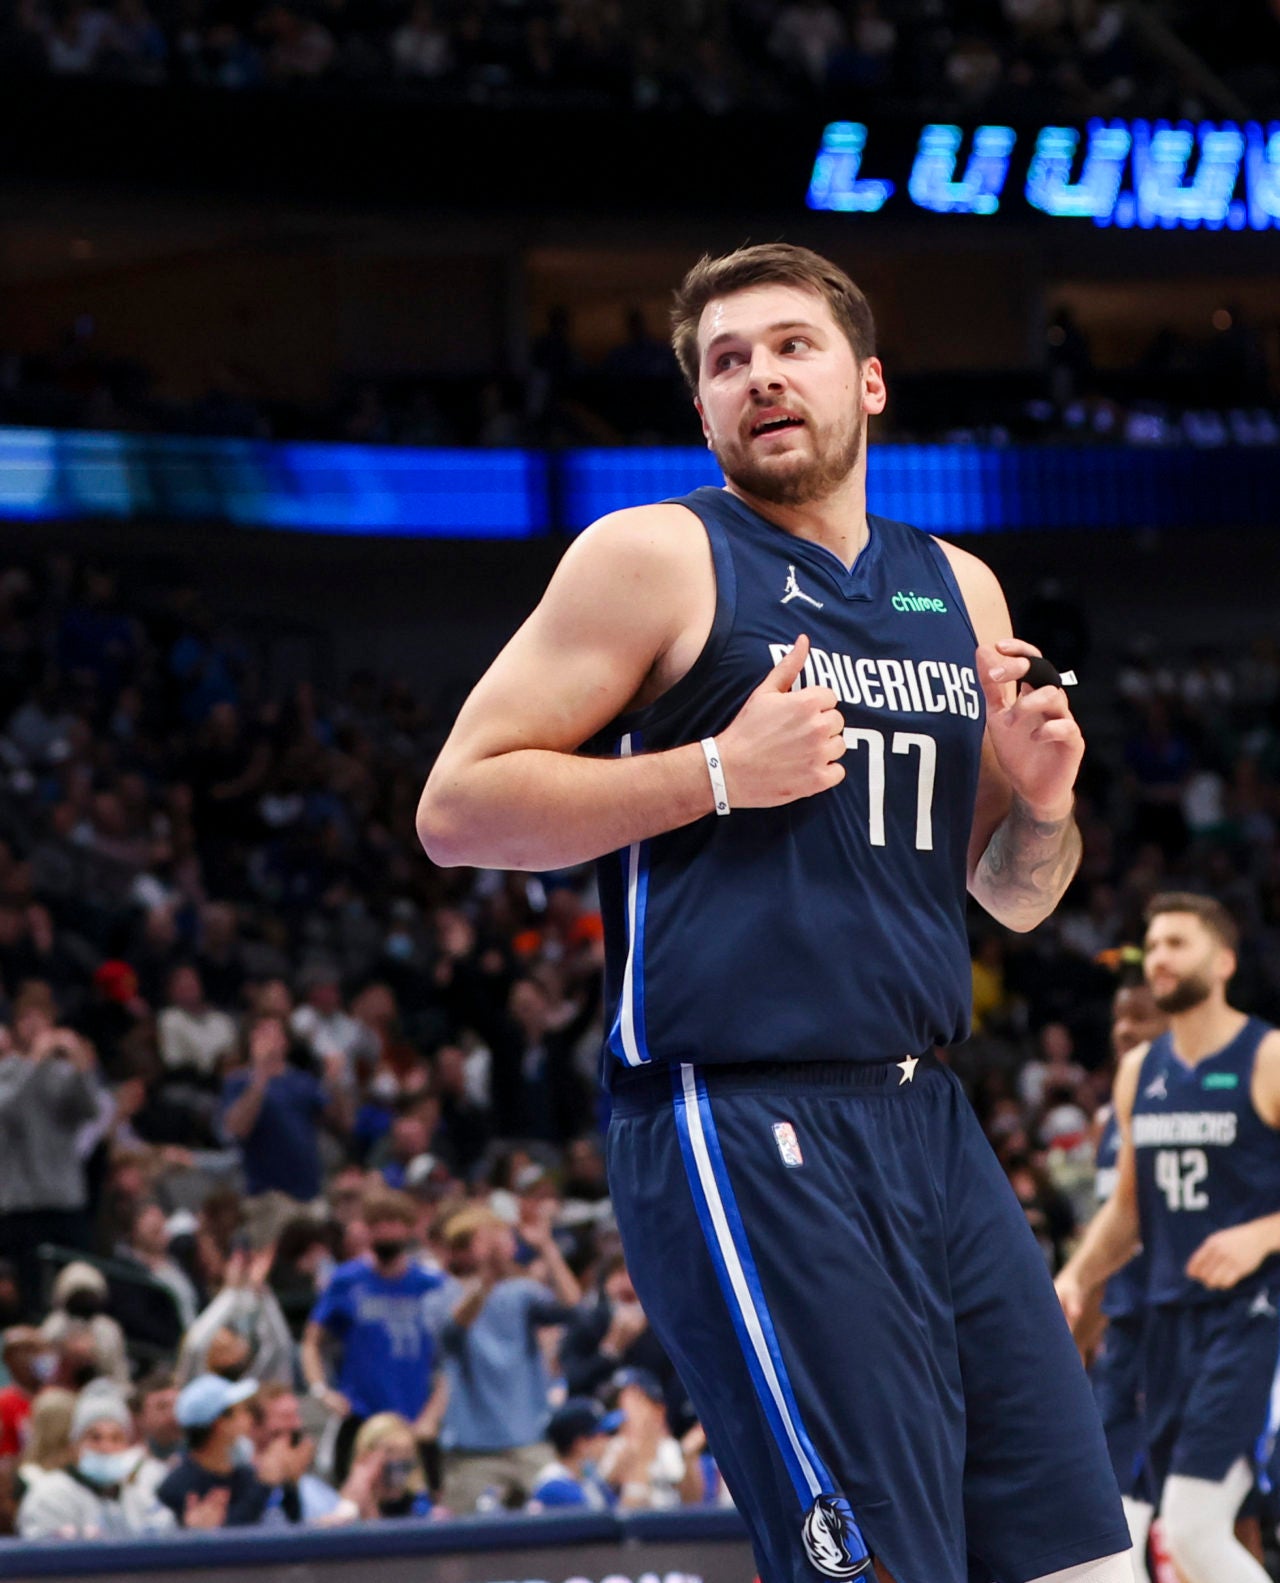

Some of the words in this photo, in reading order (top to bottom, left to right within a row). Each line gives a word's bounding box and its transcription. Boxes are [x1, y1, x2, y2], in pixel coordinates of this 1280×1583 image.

[891, 591, 947, 613] chime
[842, 726, 937, 851] 77
[1155, 1148, 1210, 1212] 42
